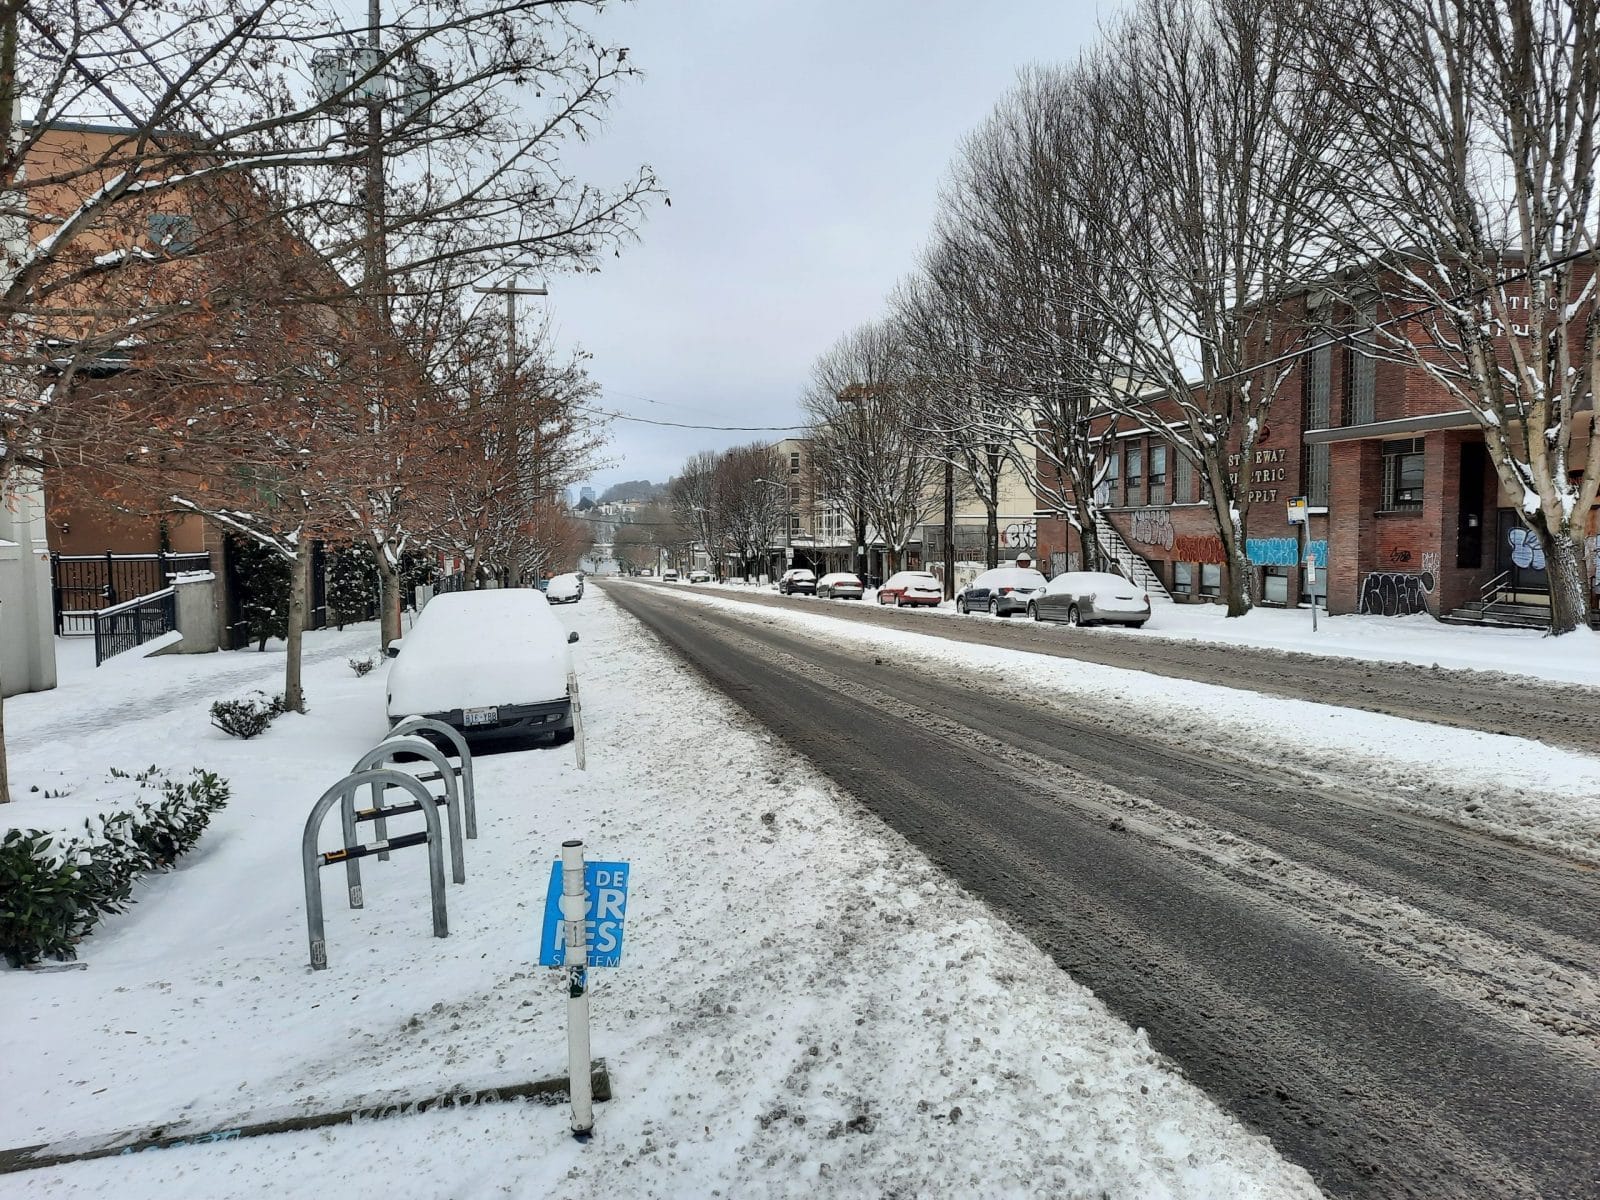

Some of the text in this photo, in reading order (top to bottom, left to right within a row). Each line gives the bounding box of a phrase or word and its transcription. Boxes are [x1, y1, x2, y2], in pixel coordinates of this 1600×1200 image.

[1228, 449, 1285, 467] STEWAY
[1233, 490, 1277, 503] PPLY
[595, 870, 629, 888] DE
[554, 919, 624, 953] ES
[552, 954, 620, 967] STEM
